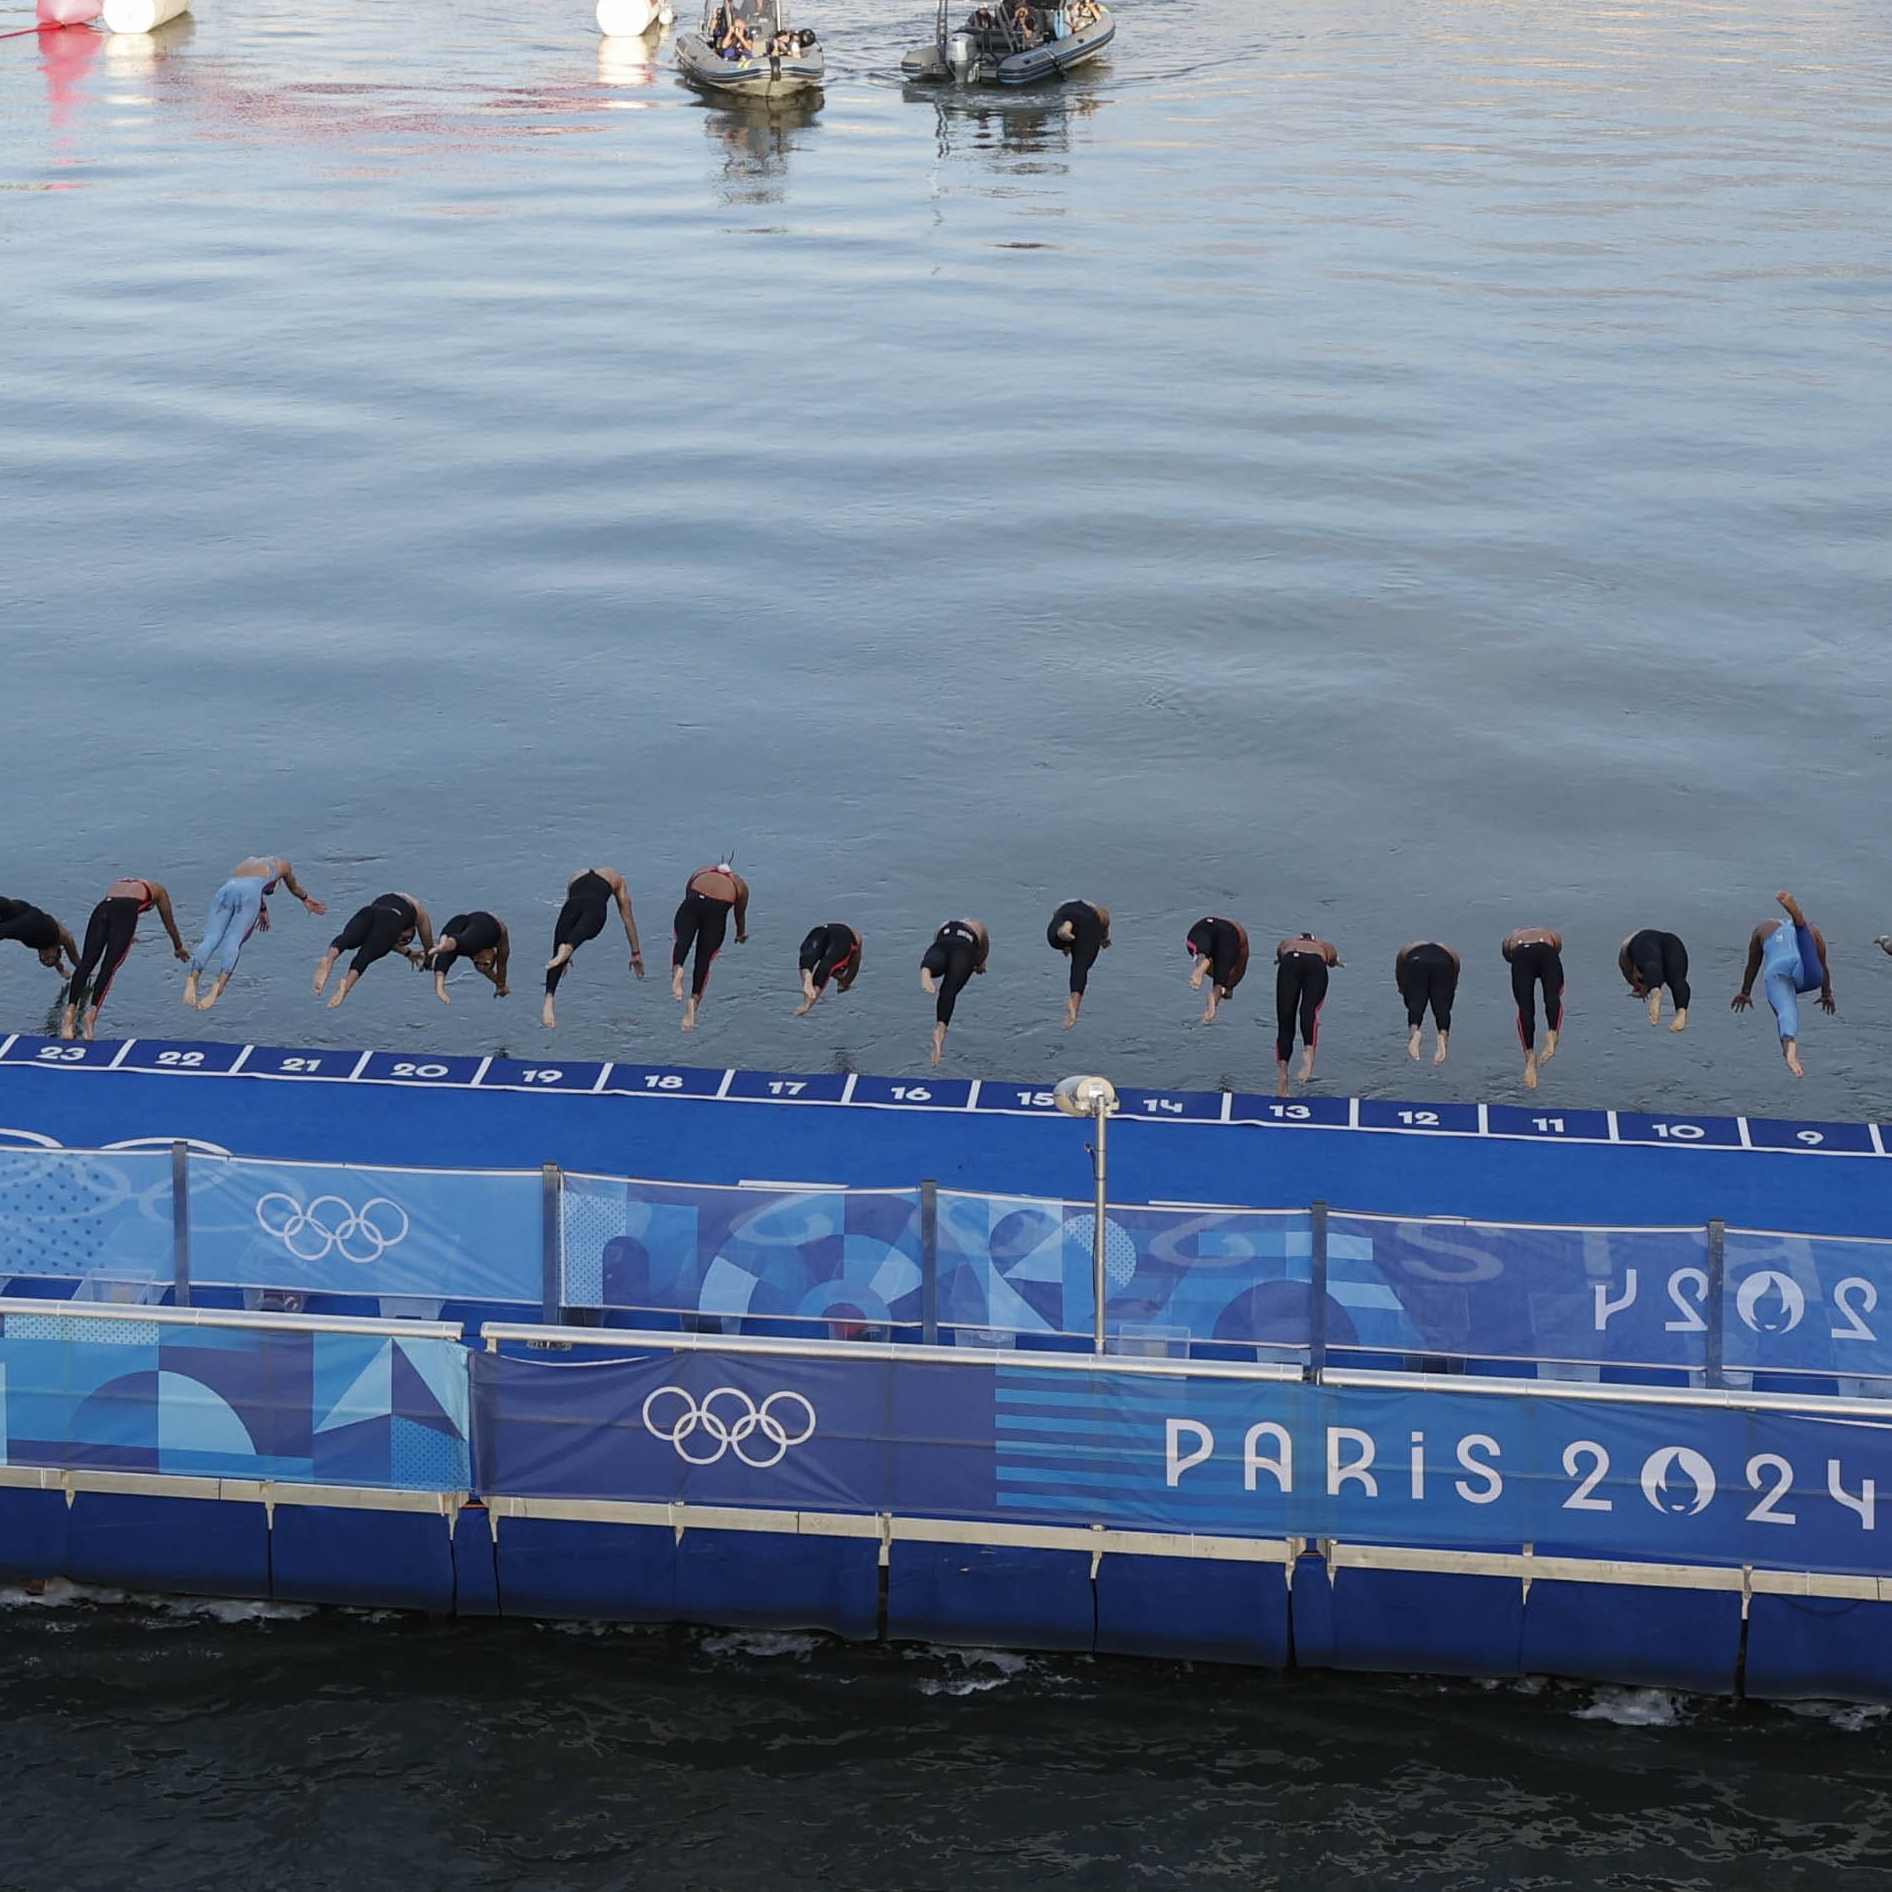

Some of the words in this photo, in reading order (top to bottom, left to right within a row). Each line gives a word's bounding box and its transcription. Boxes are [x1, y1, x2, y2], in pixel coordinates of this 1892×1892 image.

[35, 1045, 87, 1062] 23
[154, 1050, 206, 1067] 22
[278, 1056, 322, 1073] 21
[390, 1062, 449, 1079] 20
[522, 1068, 564, 1085] 19
[644, 1074, 685, 1090] 18
[768, 1081, 807, 1096] 17
[890, 1085, 932, 1102] 16
[1016, 1091, 1054, 1107] 15
[1143, 1098, 1184, 1114] 14
[1268, 1104, 1311, 1120] 13
[1397, 1110, 1440, 1126] 12
[1532, 1117, 1565, 1133] 11
[1651, 1122, 1705, 1139] 10
[1796, 1130, 1824, 1145] 9
[1560, 1440, 1876, 1531] 2024
